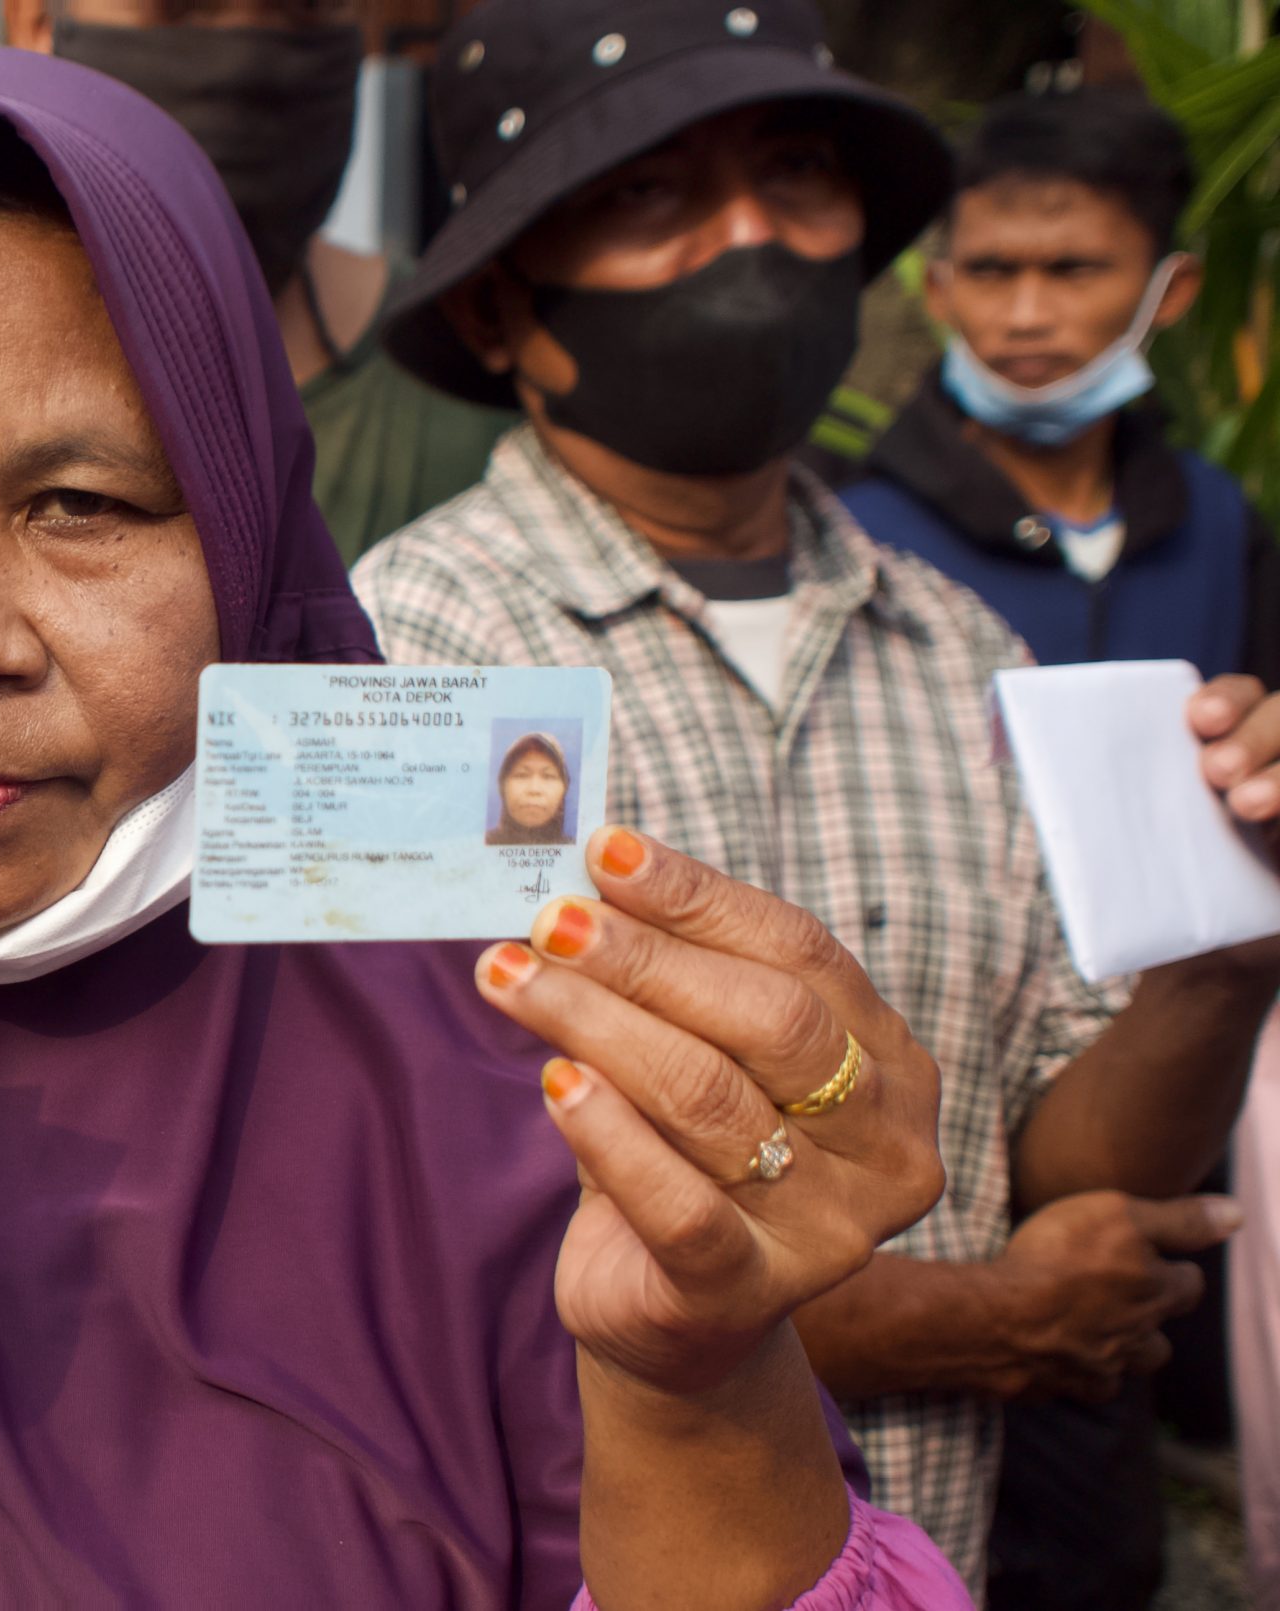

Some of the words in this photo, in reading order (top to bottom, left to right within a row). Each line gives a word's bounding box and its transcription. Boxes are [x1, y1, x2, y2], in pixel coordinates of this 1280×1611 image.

[329, 676, 396, 689] PROVINSI
[399, 677, 437, 689] JAWA
[441, 677, 487, 689] BARAT
[362, 691, 400, 703] KOTA
[406, 691, 452, 703] DEPOK
[207, 711, 236, 726] NIK
[288, 711, 464, 727] 3276065510640001
[294, 763, 359, 773] PEREMPUAN
[499, 848, 526, 857] KOTA
[528, 848, 562, 857] DEPOK
